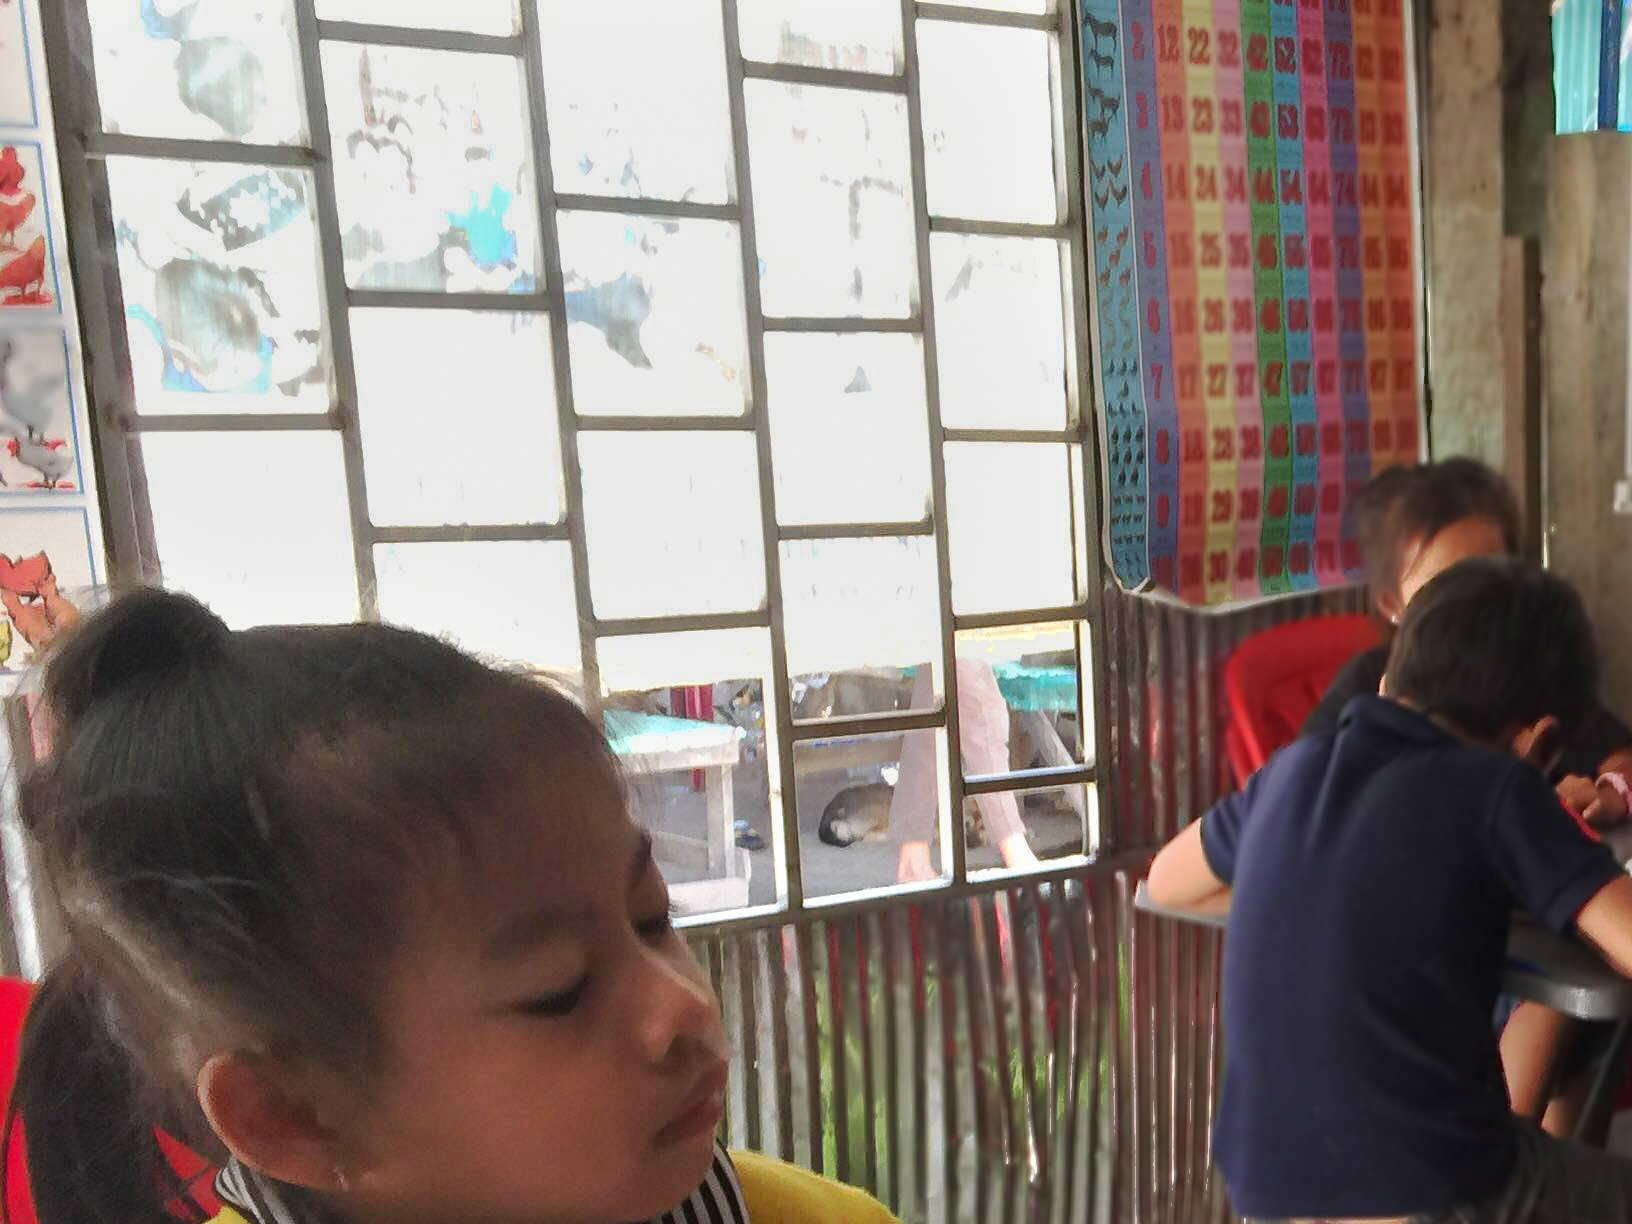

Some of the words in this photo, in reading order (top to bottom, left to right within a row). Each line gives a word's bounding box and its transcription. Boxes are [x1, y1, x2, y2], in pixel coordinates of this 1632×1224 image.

[1158, 24, 1179, 64] 12
[1188, 28, 1210, 65] 22
[1274, 36, 1296, 73] 52
[1192, 96, 1213, 133] 23
[1166, 163, 1187, 200] 14
[1196, 166, 1217, 201] 24
[1200, 233, 1221, 269] 25
[1151, 363, 1162, 400] 7
[1208, 363, 1227, 398] 27
